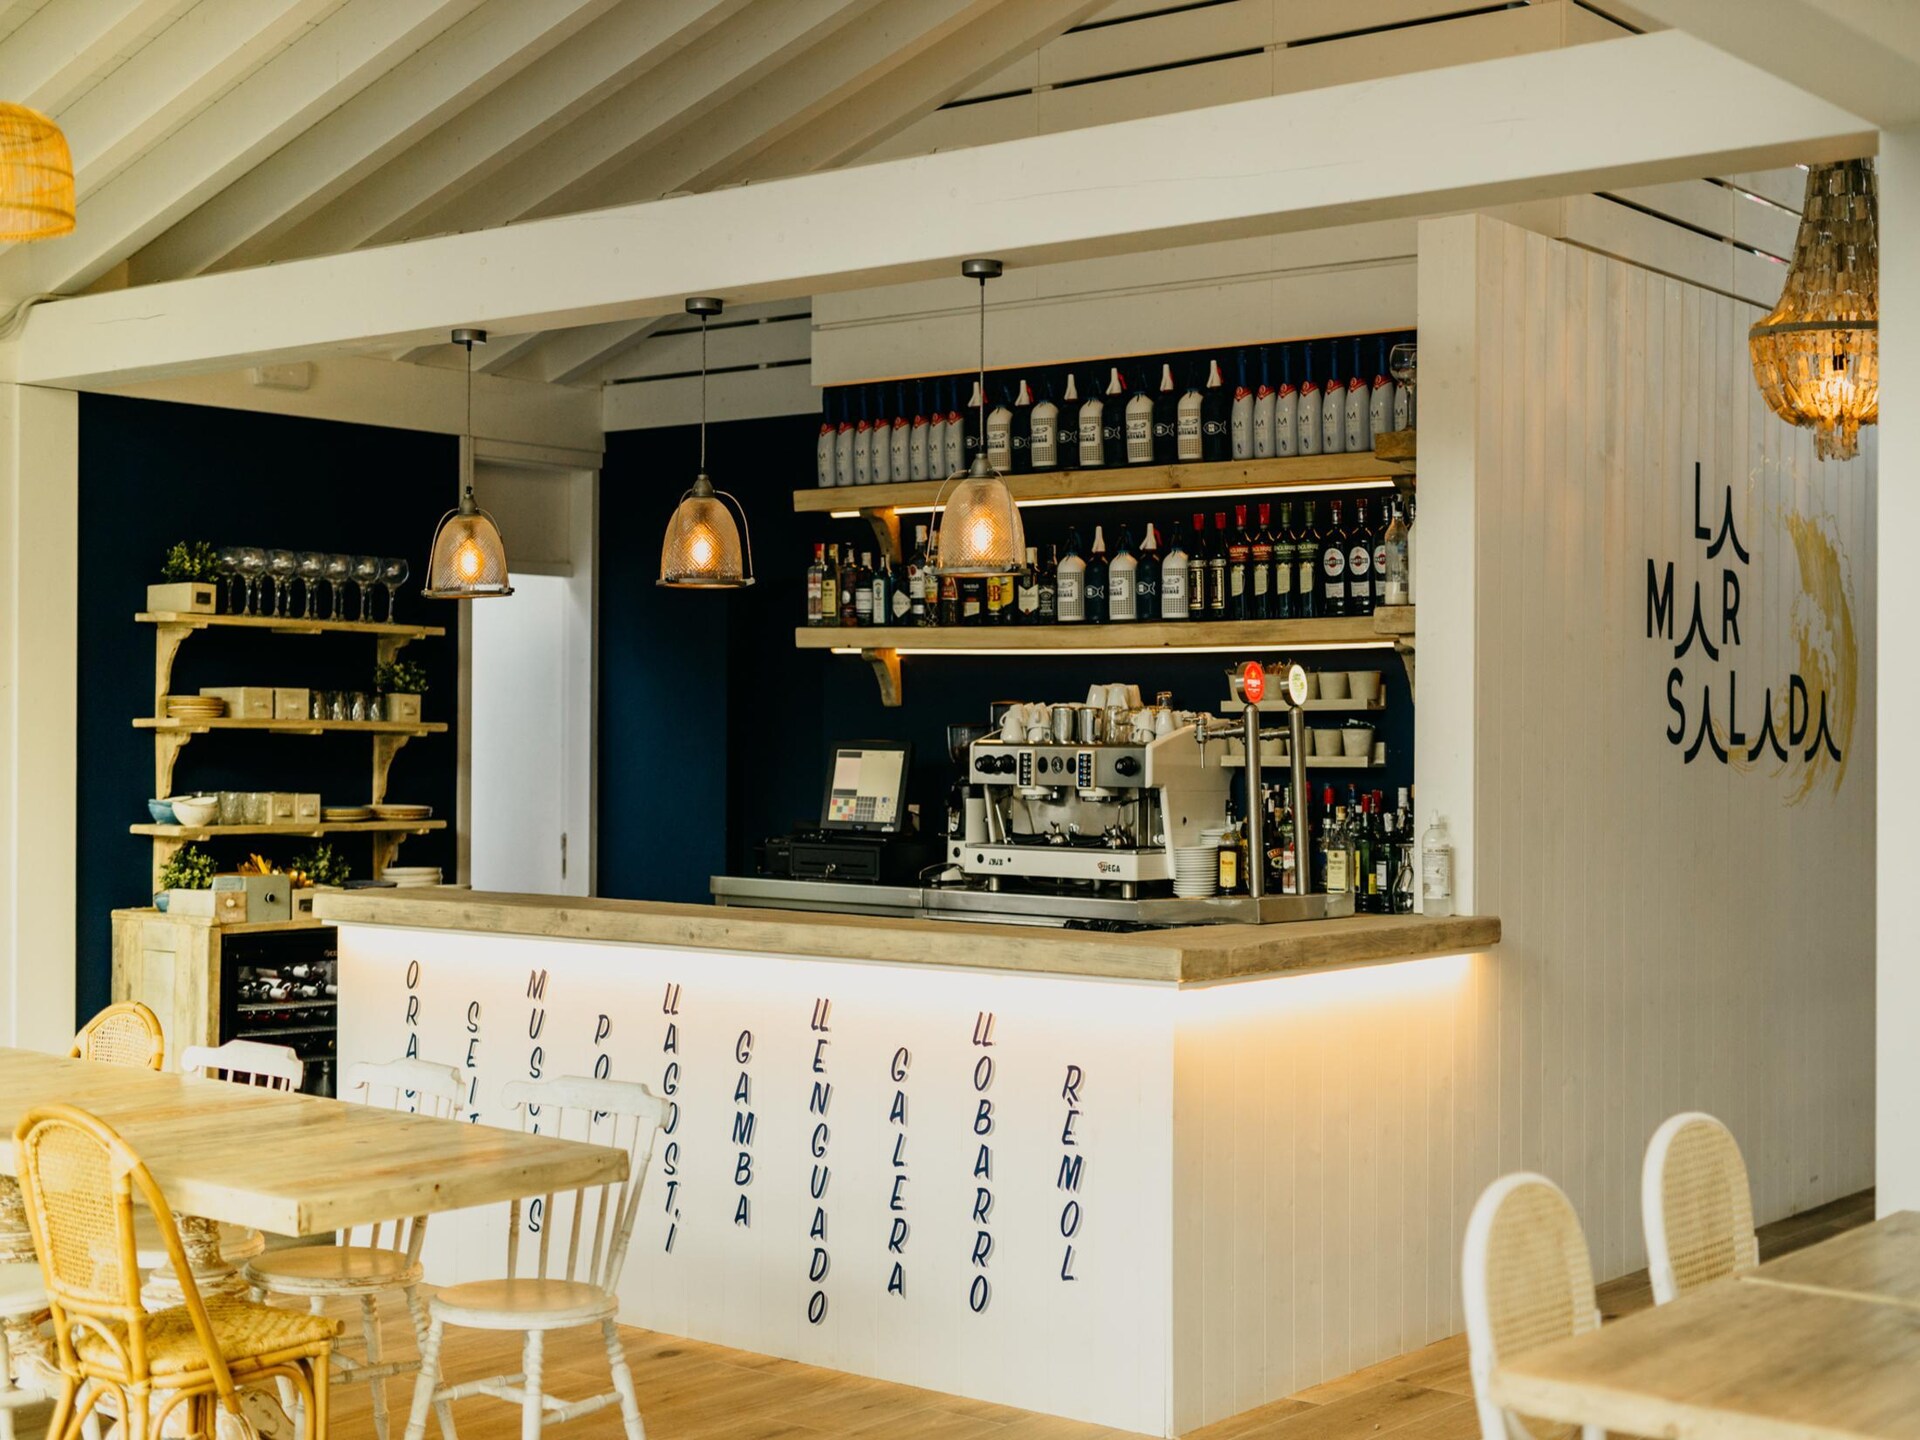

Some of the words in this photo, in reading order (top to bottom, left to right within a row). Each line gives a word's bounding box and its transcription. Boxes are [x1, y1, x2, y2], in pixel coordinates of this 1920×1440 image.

[1646, 558, 1741, 662] MAR
[1695, 461, 1749, 565] LA
[1666, 667, 1841, 764] SALADA
[732, 1029, 757, 1228] GAMBA
[808, 997, 833, 1325] LLENGUADO
[887, 1046, 911, 1298] GALERA
[969, 1011, 996, 1314] LLOBARRO
